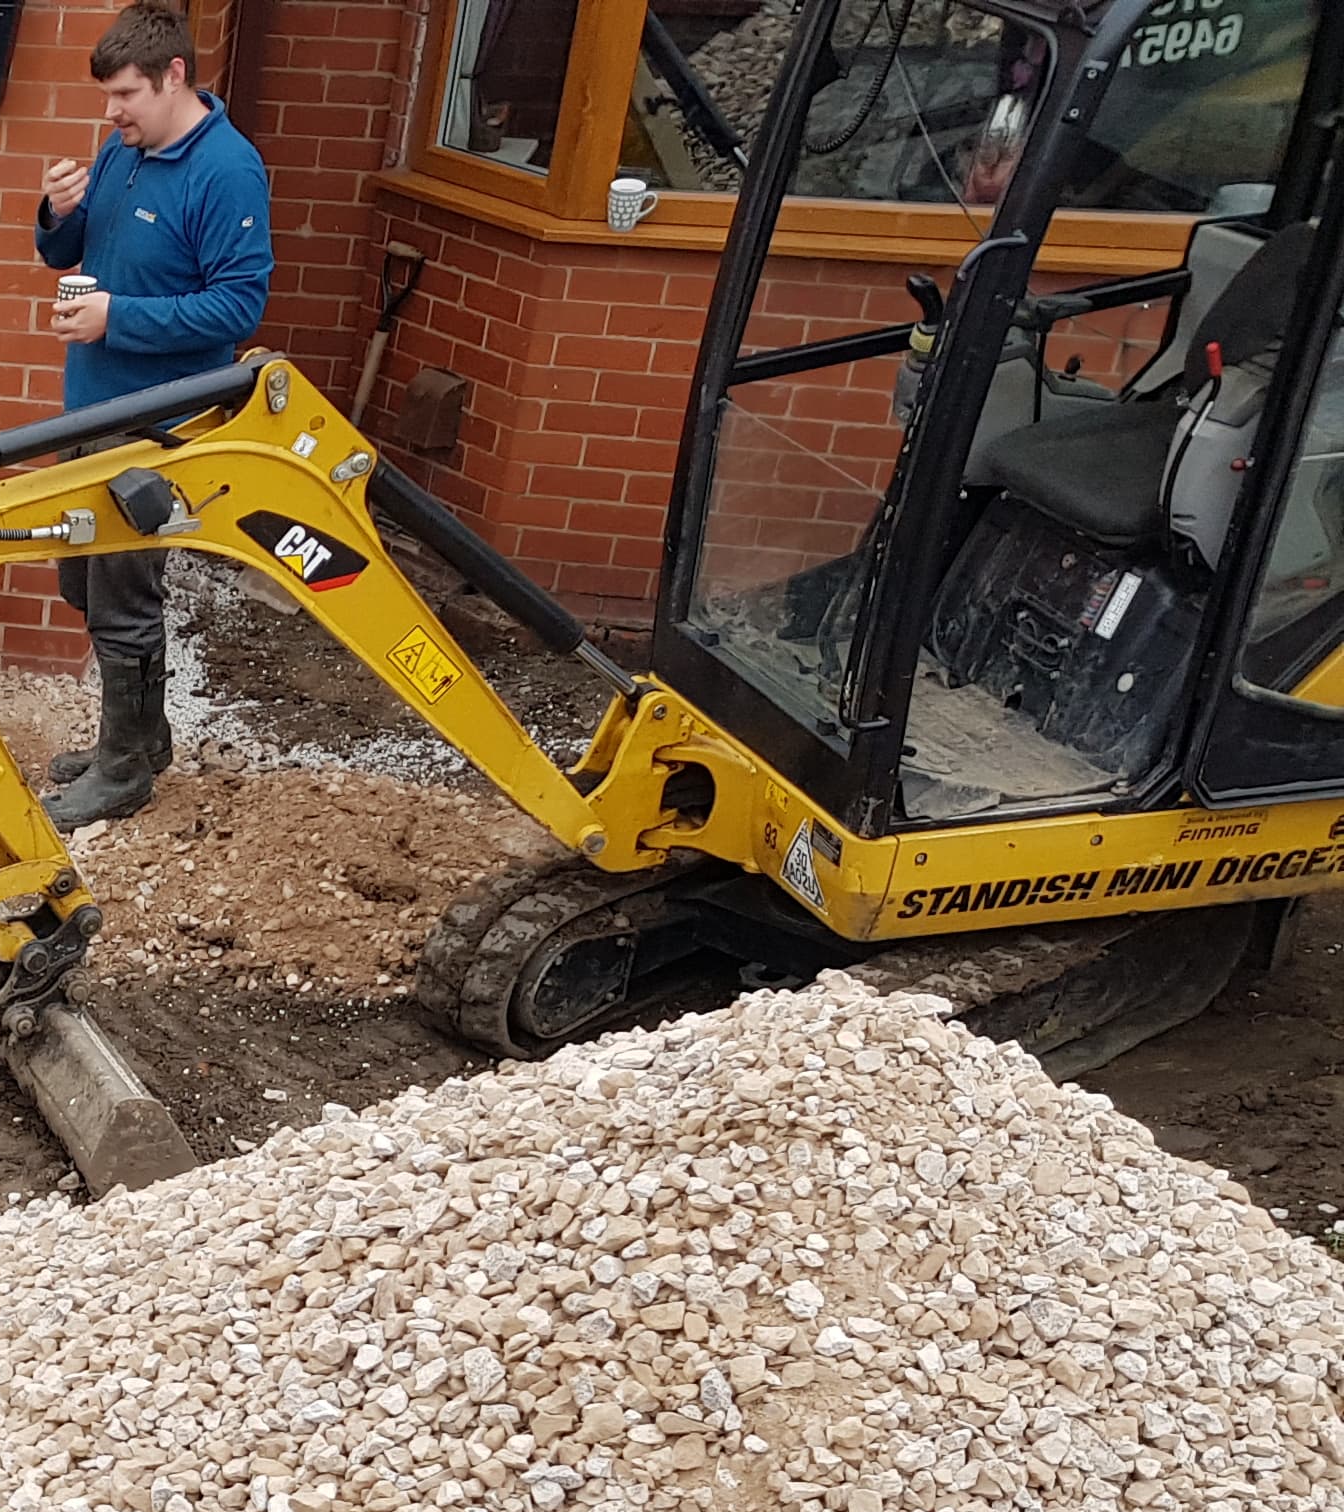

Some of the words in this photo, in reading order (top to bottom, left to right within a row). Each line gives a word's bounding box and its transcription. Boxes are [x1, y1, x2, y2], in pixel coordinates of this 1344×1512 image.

[274, 525, 332, 579] CAT
[765, 823, 777, 849] 93
[1177, 822, 1261, 842] FINNING
[896, 870, 1101, 919] STANDISH
[1103, 859, 1204, 898] MINI
